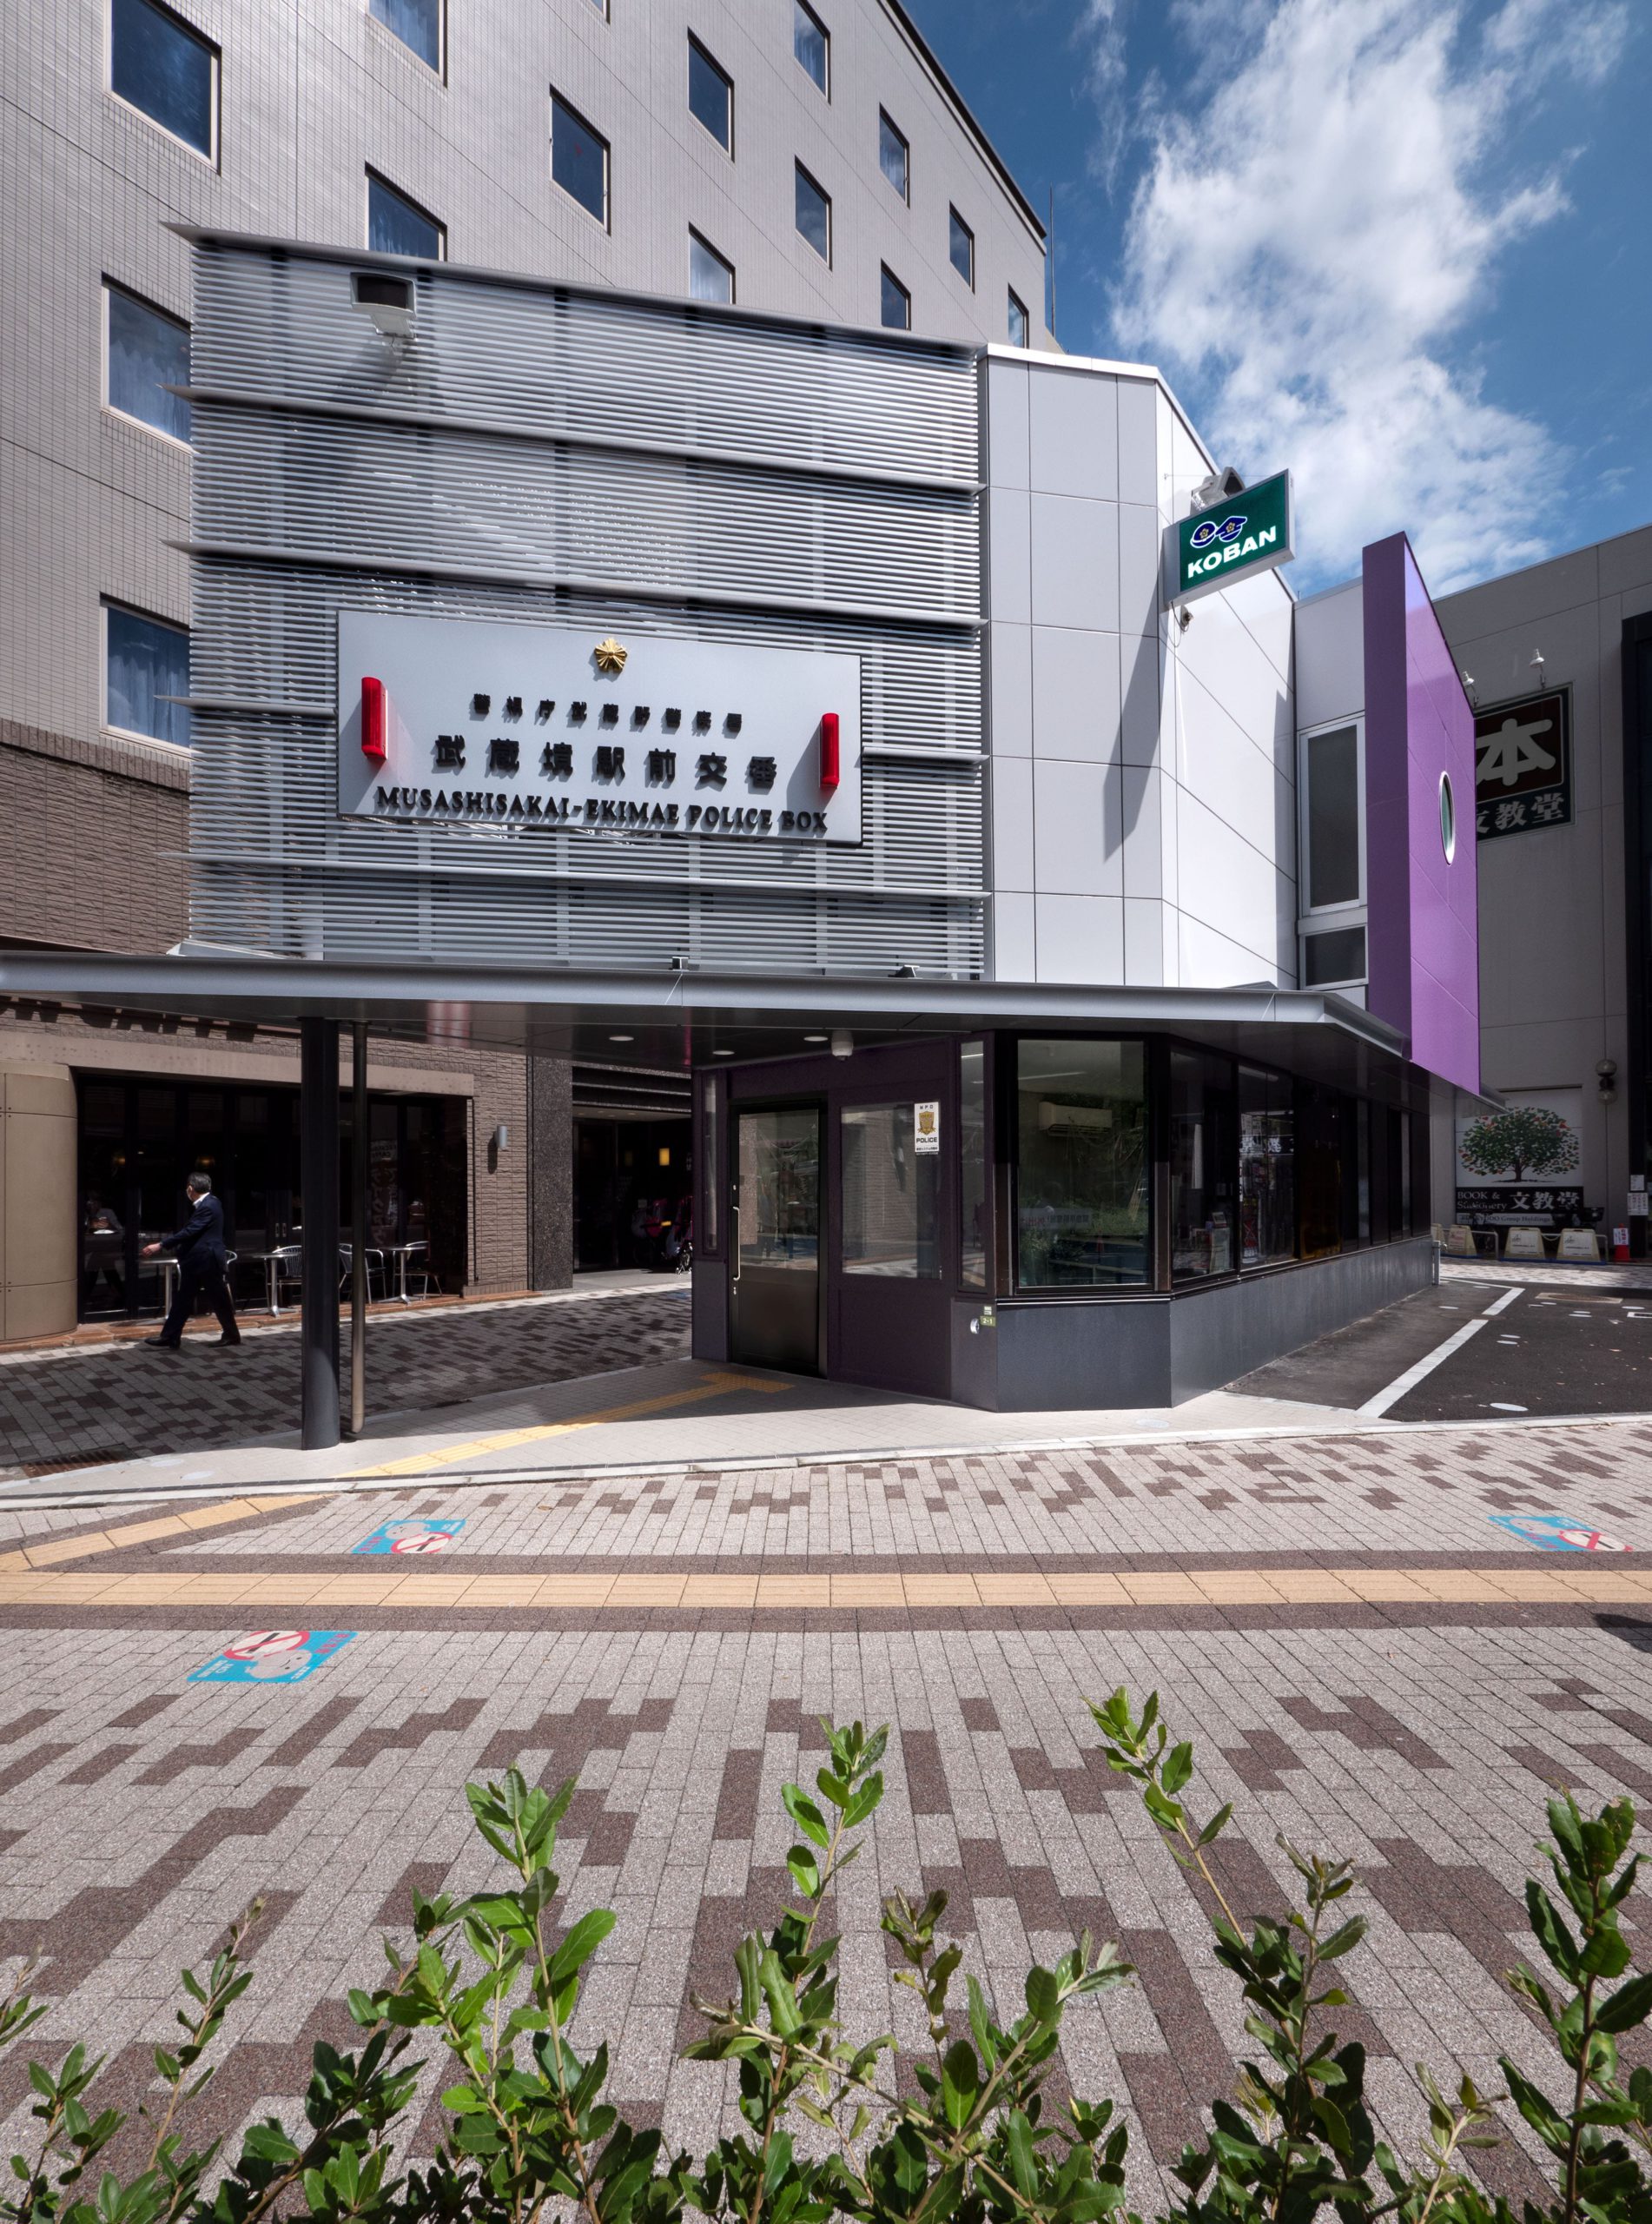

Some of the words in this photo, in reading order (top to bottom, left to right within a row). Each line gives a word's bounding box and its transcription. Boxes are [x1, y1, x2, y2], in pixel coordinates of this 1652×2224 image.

[1186, 525, 1277, 579] KOBAN
[435, 733, 777, 788] 武蔵境駅前交番
[1476, 718, 1556, 787] 本
[377, 785, 679, 824] MUSASHISAKAI-EKIMAE
[689, 804, 773, 830] POLICE
[782, 810, 829, 832] BOX
[1457, 1191, 1488, 1200] BOOK
[1491, 1191, 1501, 1200] &
